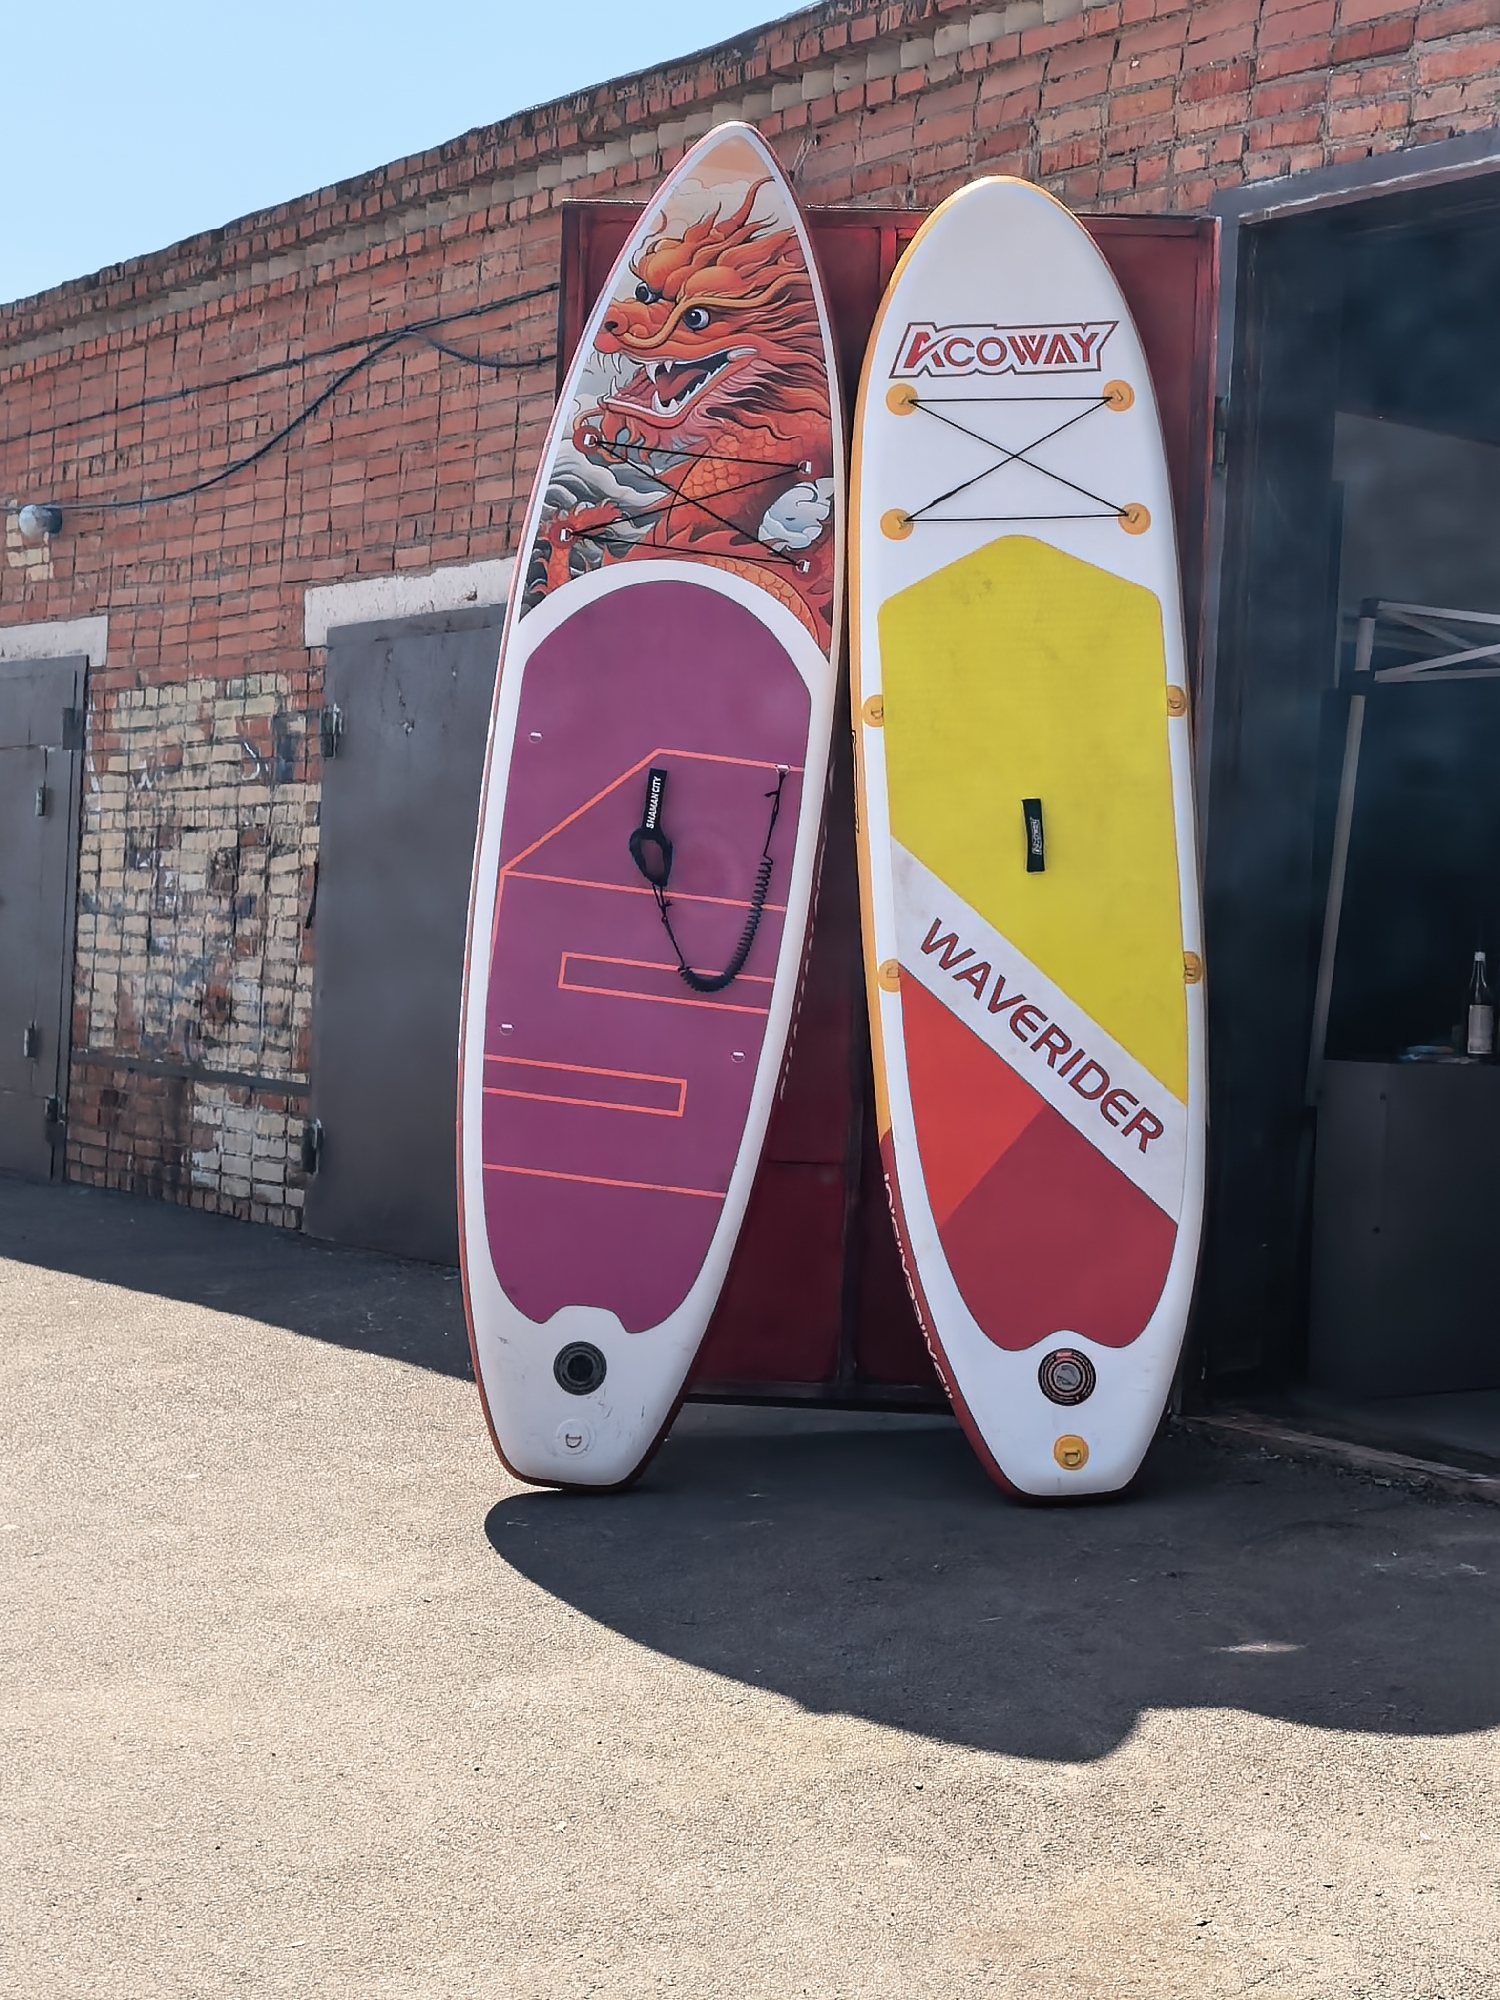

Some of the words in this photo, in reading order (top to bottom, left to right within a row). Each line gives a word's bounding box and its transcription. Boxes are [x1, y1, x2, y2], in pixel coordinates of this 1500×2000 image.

[902, 330, 1103, 371] ACOWAY
[652, 776, 661, 792] CITY
[646, 793, 659, 829] SHAMAN
[920, 917, 1164, 1154] WAVERIDER
